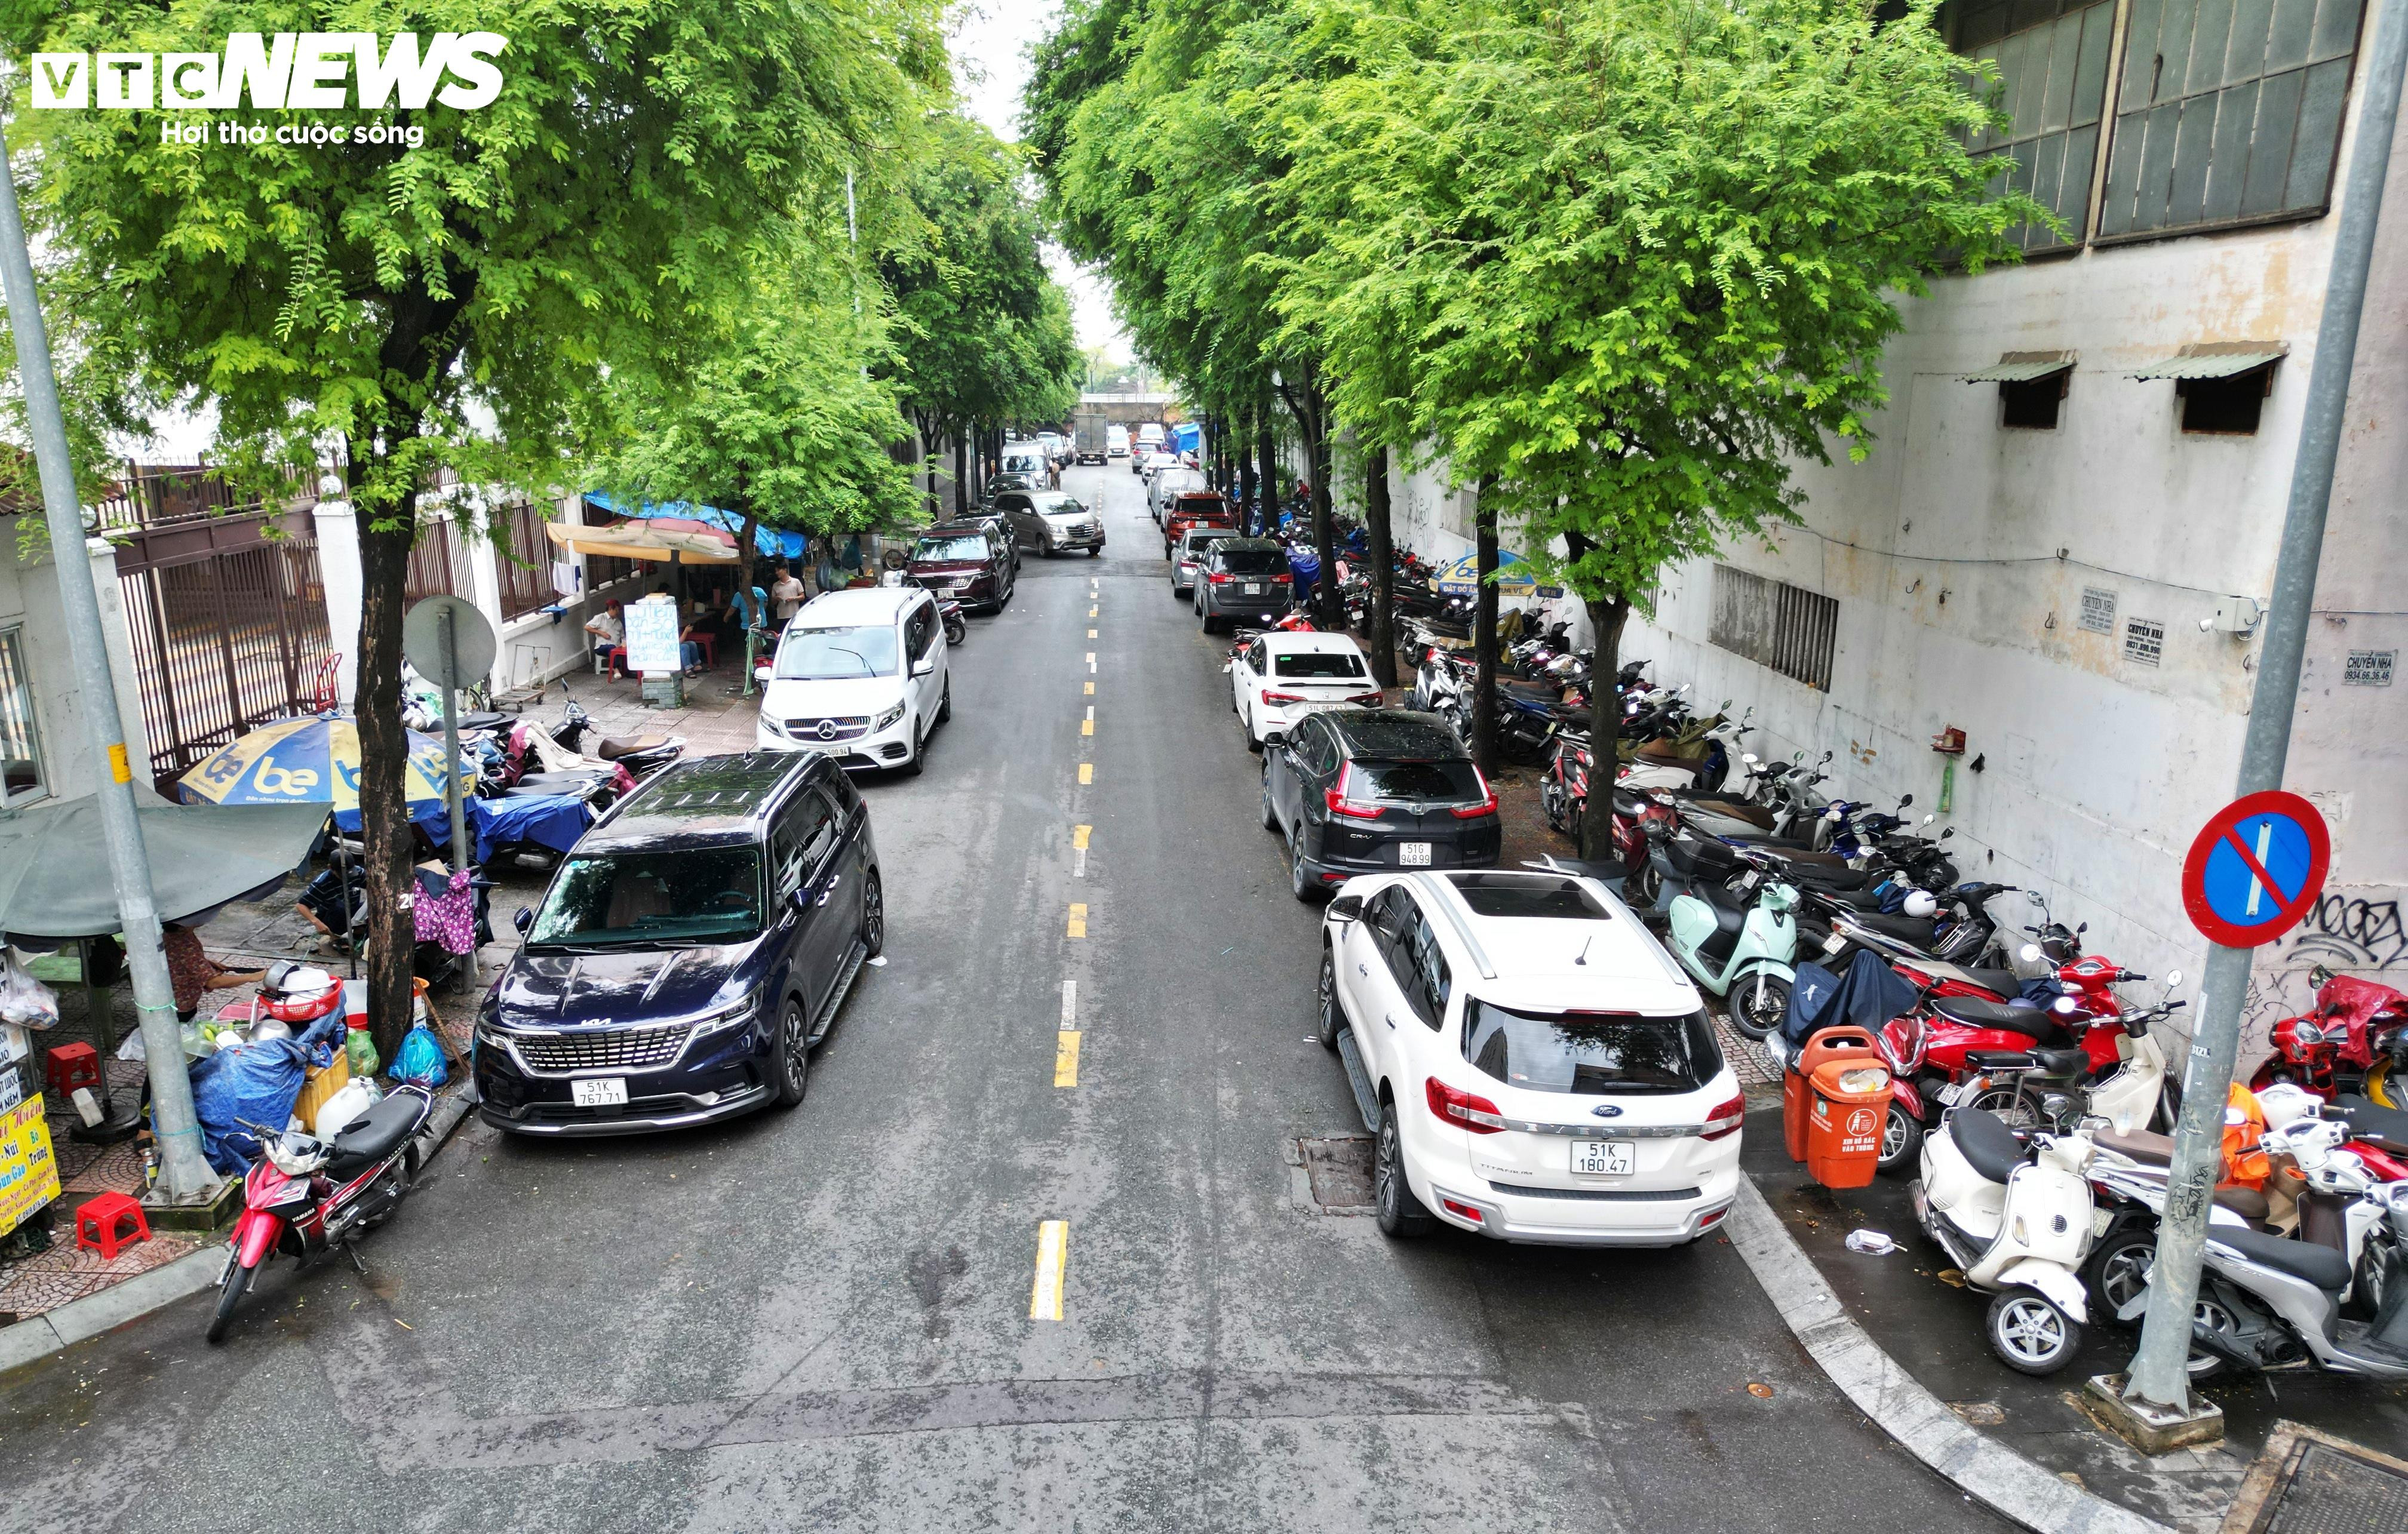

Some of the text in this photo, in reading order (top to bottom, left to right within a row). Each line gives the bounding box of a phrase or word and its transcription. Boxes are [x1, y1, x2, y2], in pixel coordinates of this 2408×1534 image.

[253, 756, 319, 796] be
[1407, 844, 1424, 853] 51G
[1401, 854, 1430, 864] 948.99
[587, 1081, 610, 1092] 51K
[579, 1093, 621, 1105] 767.71
[1597, 1105, 1619, 1116] Ford
[1589, 1143, 1616, 1157] 51K
[1579, 1158, 1627, 1173] 180.47
[291, 1207, 317, 1223] YAMAHA
